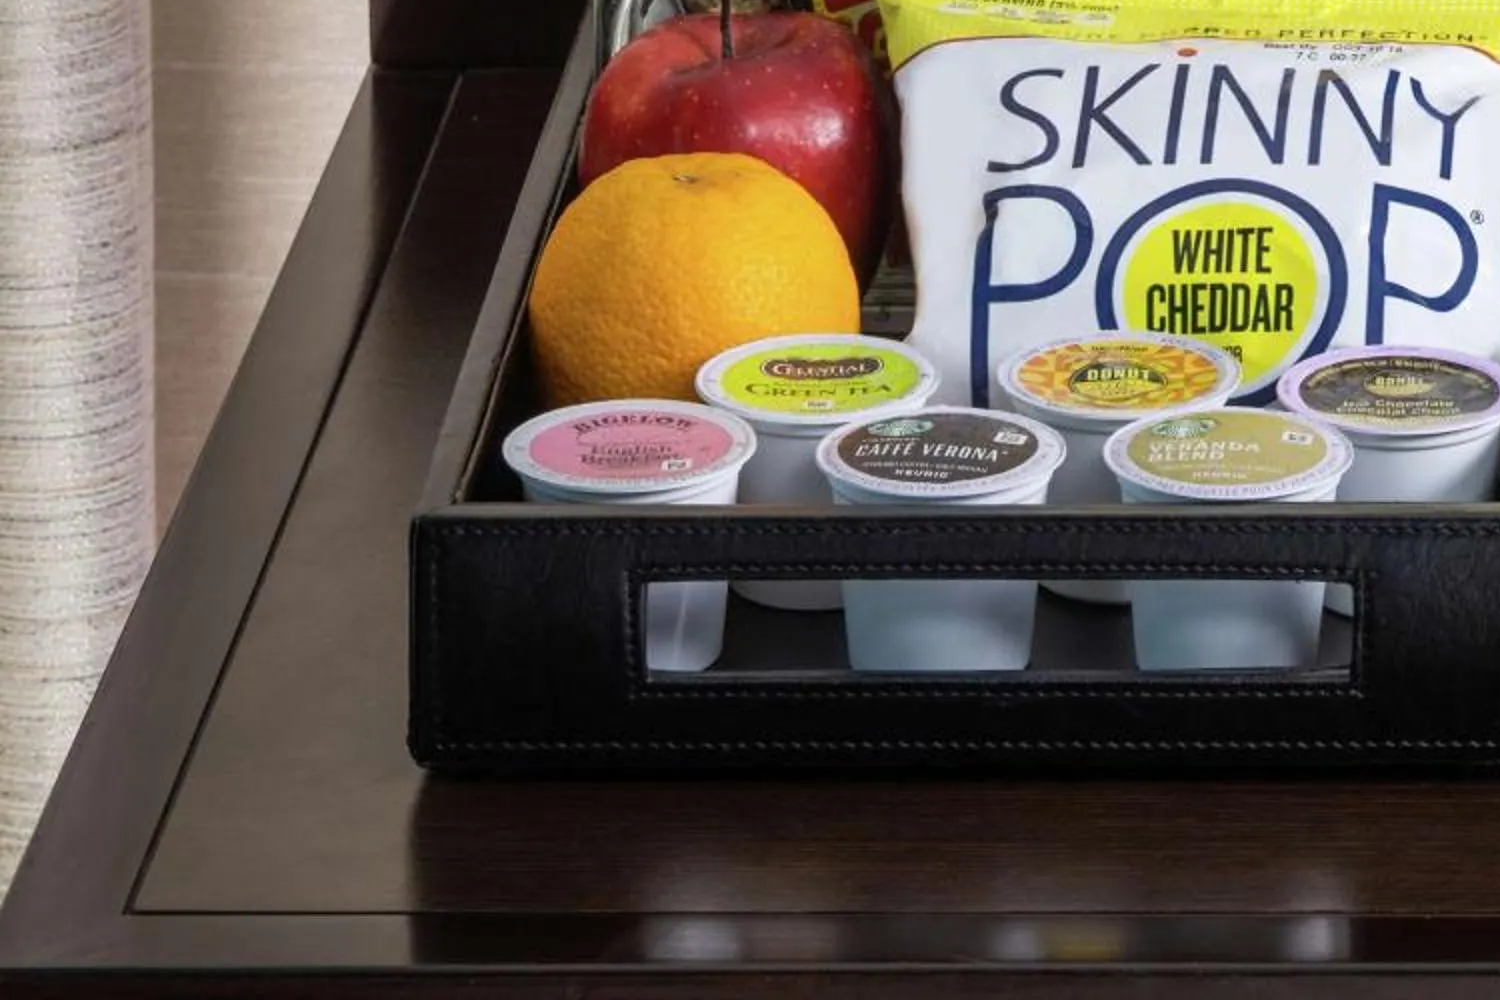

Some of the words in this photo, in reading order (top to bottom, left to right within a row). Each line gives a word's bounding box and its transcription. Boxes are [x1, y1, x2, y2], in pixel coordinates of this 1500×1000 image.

[1278, 28, 1474, 43] PERFECTION
[987, 47, 1482, 180] SKINNY
[1172, 226, 1275, 276] WHITE
[970, 178, 1481, 404] POP
[1146, 283, 1295, 335] CHEDDAR
[745, 382, 838, 397] GREEN
[848, 383, 892, 396] TEA
[1086, 367, 1150, 381] DONUT
[922, 442, 999, 463] VERONA
